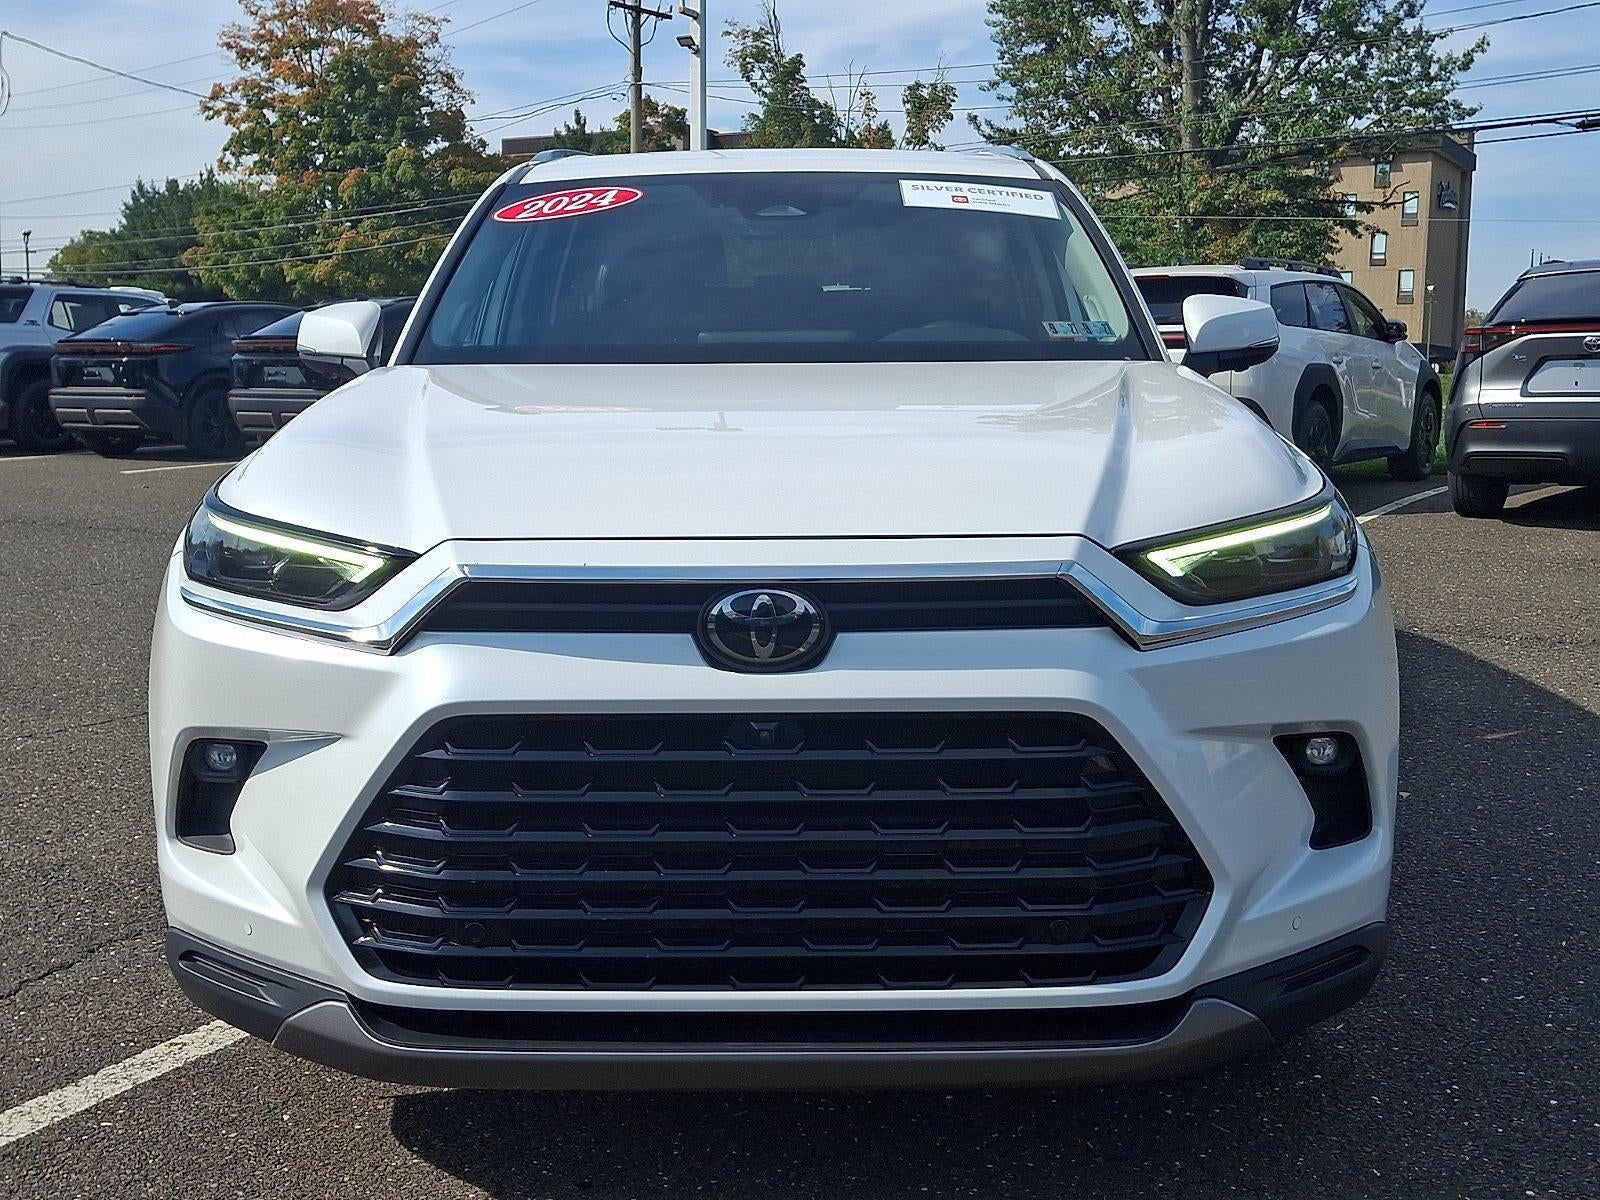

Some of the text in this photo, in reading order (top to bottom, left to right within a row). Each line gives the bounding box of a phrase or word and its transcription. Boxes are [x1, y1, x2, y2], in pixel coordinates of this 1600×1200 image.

[515, 189, 619, 220] 2024
[911, 184, 1044, 201] SILVER CERTIFIED
